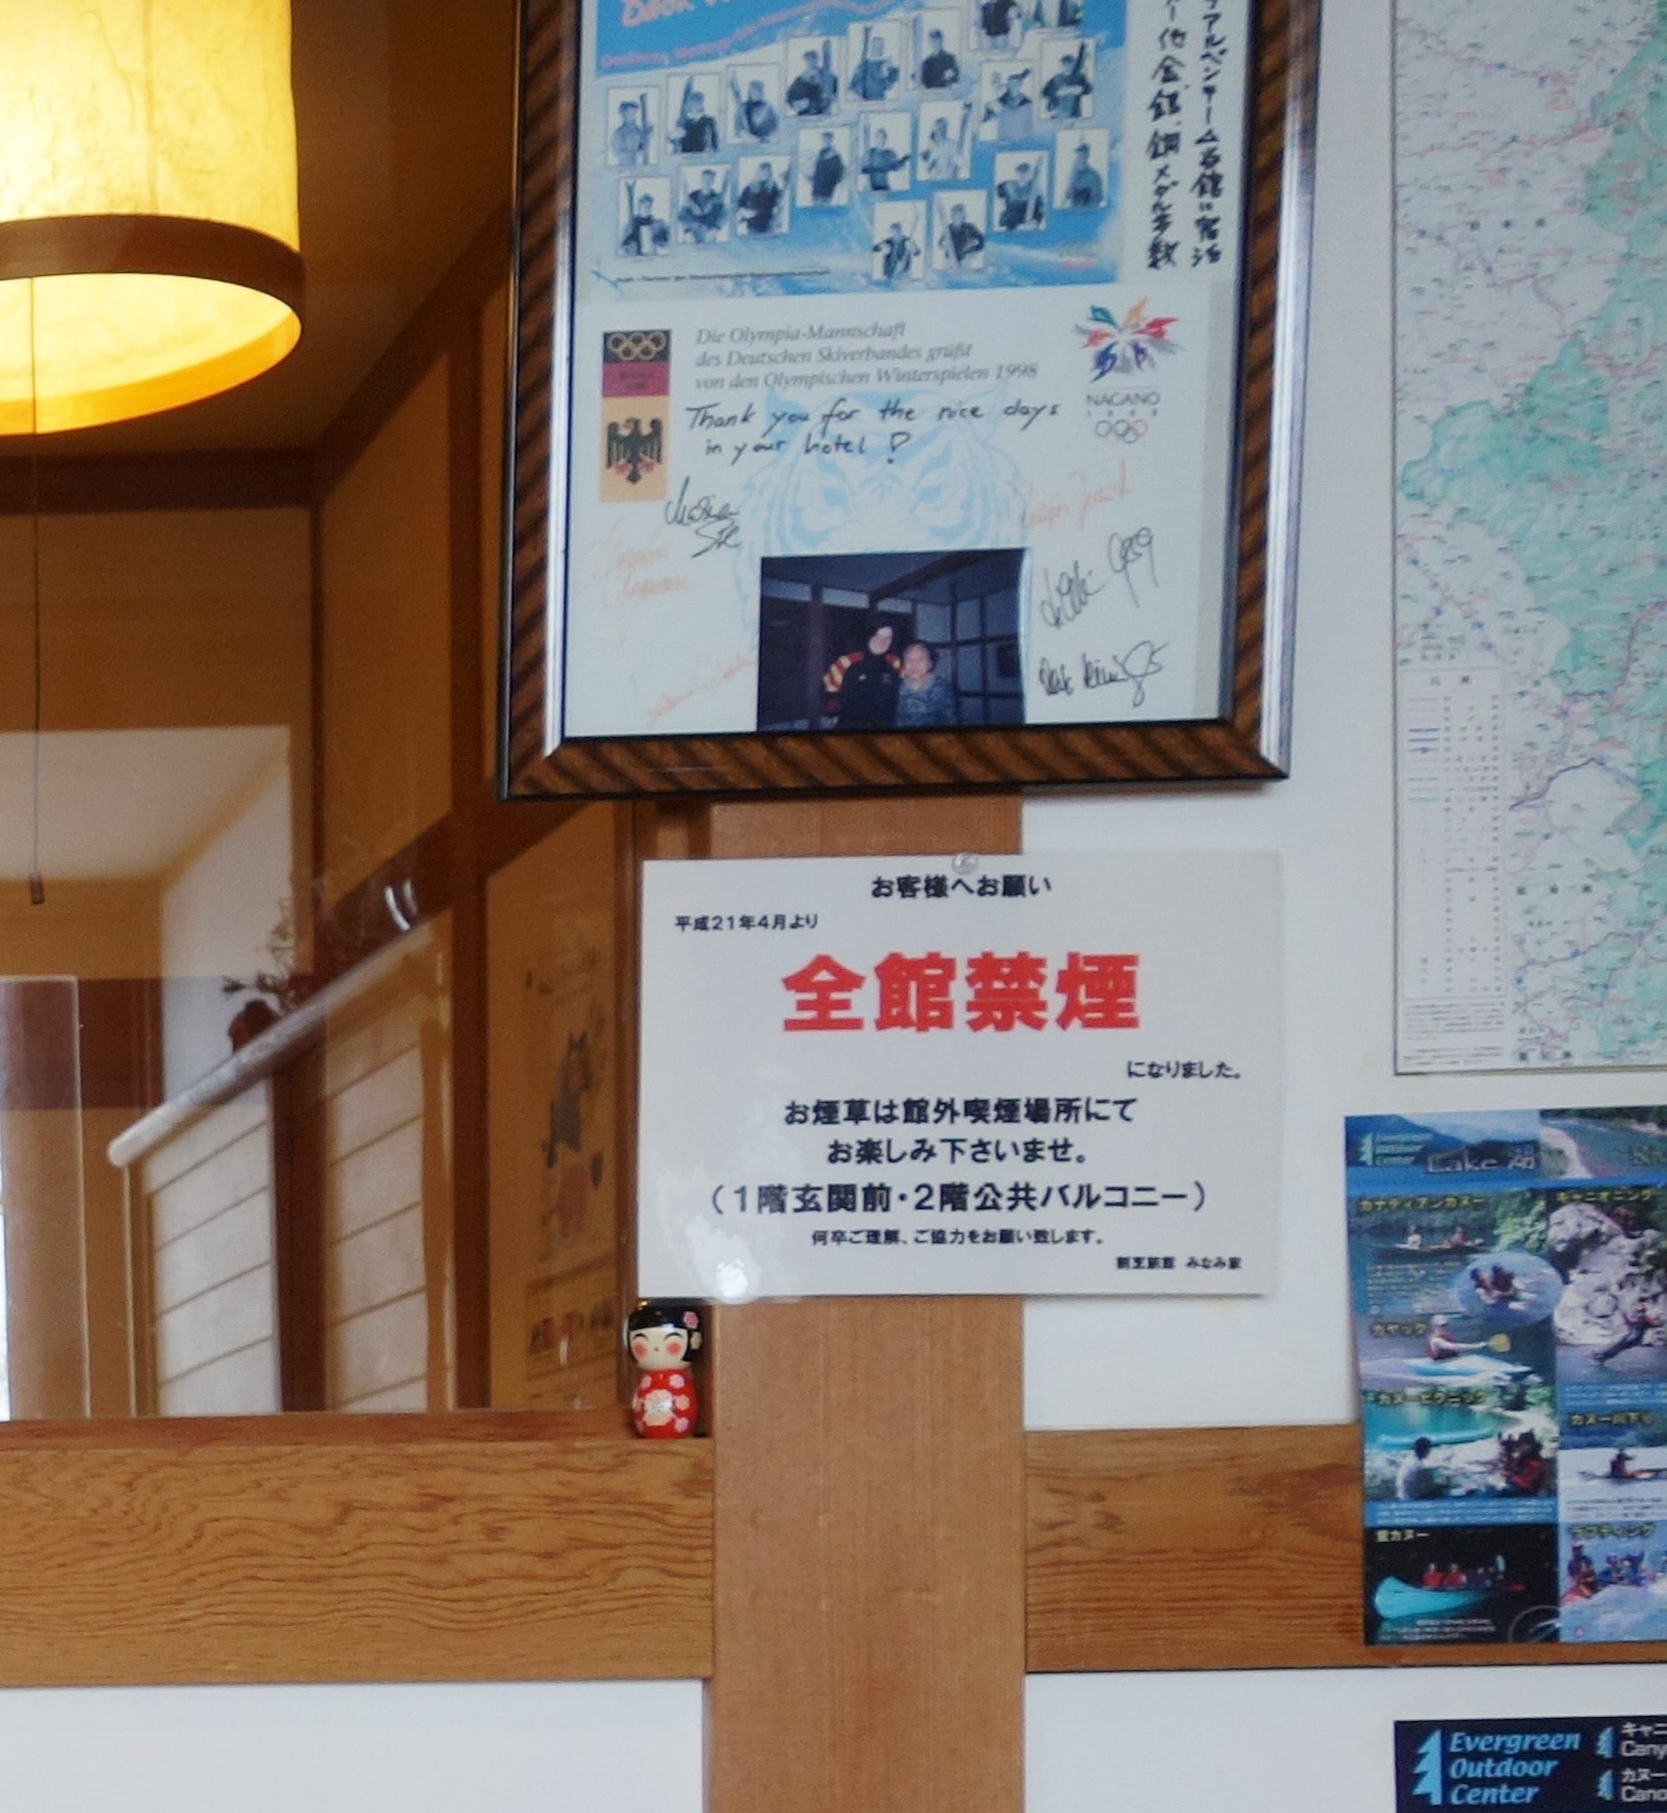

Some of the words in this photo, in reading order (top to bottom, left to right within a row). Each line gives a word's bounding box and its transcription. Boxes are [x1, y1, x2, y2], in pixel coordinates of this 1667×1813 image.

[685, 402, 756, 431] Thank
[762, 406, 811, 438] you
[821, 398, 860, 438] for
[879, 398, 916, 422] the
[937, 400, 985, 421] nice
[1003, 398, 1061, 432] days
[705, 436, 722, 456] in
[731, 439, 787, 466] your
[804, 433, 867, 456] hotel
[871, 875, 1052, 899] お客様へお願い
[675, 913, 819, 933] 平成21年4月より
[782, 951, 1140, 1033] 全館禁煙
[1127, 1061, 1242, 1080] になりました。
[784, 1098, 1137, 1127] お煙草は館外喫煙場所にて
[827, 1137, 1088, 1166] お楽しみ下さいませ。
[1450, 1732, 1582, 1755] Evergreen
[1450, 1757, 1558, 1779] Outdoor
[1450, 1784, 1540, 1806] Center
